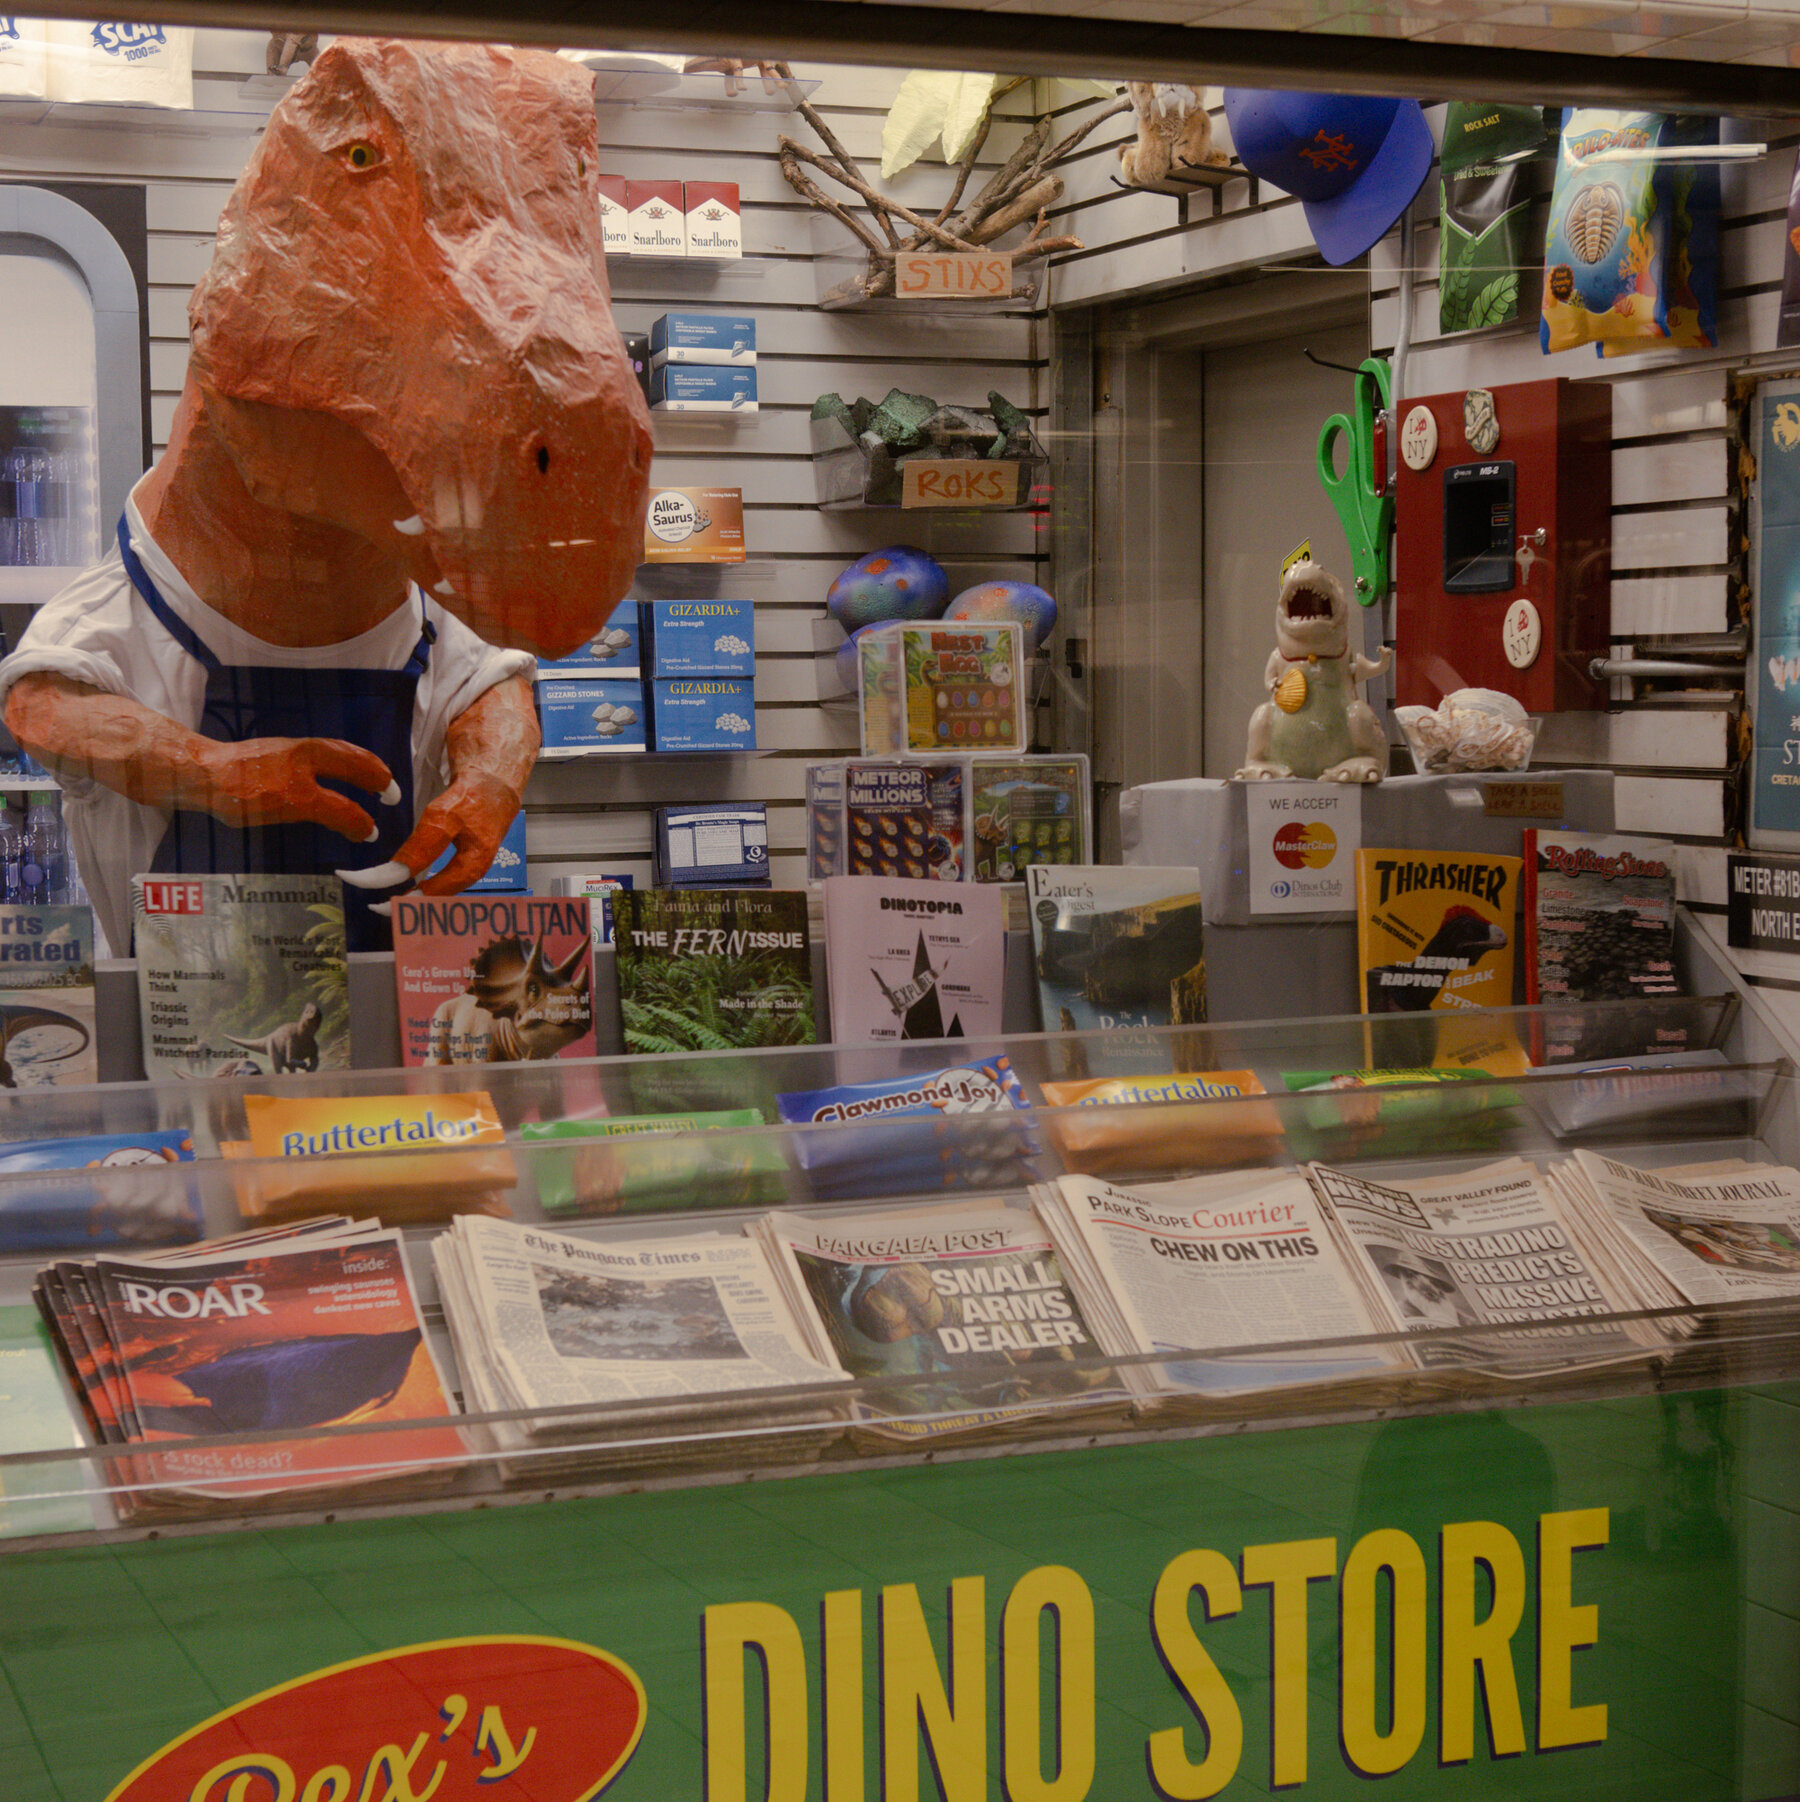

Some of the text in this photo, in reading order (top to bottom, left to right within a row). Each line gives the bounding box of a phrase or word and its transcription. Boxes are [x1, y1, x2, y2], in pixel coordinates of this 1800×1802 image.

[124, 47, 148, 62] 1000
[1463, 114, 1500, 133] ROCK SALT
[634, 230, 682, 246] Snarlboro
[691, 232, 738, 248] Snarlboro
[902, 259, 1005, 293] STIXS
[1408, 440, 1428, 460] NY
[918, 470, 1004, 500] ROKS
[654, 500, 684, 513] Alka-
[653, 514, 693, 526] Saurus
[670, 604, 741, 616] GIZARDIA+
[680, 620, 704, 628] Strength
[1510, 634, 1530, 660] NY
[578, 690, 604, 698] STONES
[670, 683, 742, 694] GIZARDIA+
[680, 699, 706, 707] Strength
[854, 771, 922, 786] METEOR
[850, 788, 924, 804] MILLIONS
[1270, 798, 1338, 810] WE ACCEPT
[1275, 840, 1336, 851] MasterClaw
[1545, 846, 1666, 880] Rolling Stone
[1032, 868, 1094, 898] Eater's
[1321, 880, 1343, 892] Club
[1375, 861, 1507, 912] THRASHER
[1734, 866, 1772, 896] METER
[146, 886, 338, 912] LIFE Mammals
[654, 900, 772, 914] Fauna and Flora
[880, 898, 963, 915] DINOTOPIA
[398, 903, 586, 936] DINOPOLITAN
[1752, 908, 1790, 939] NORTH
[0, 939, 81, 962] rated
[631, 930, 804, 956] THE FERN ISSUE
[1414, 956, 1470, 970] DEMON
[149, 970, 226, 980] How Mammals
[1380, 973, 1444, 987] RAPTOR
[1452, 968, 1495, 990] BEAK
[149, 981, 178, 993] Think
[404, 982, 420, 992] And
[452, 982, 466, 994] Up
[546, 992, 590, 1004] Secrets of
[720, 999, 804, 1009] Made in the Shade
[151, 1002, 188, 1014] Triassic
[528, 1010, 590, 1019] the Paleo Diet
[1120, 1012, 1132, 1020] The
[152, 1016, 189, 1028] Origins
[153, 1034, 198, 1046] Mammal
[409, 1033, 442, 1044] Fashion
[206, 1048, 250, 1059] Paradise
[1080, 1078, 1241, 1107] Buttertalon
[813, 1082, 997, 1123] Clawmond Joy
[283, 1110, 480, 1156] Buttertalon
[1602, 1159, 1627, 1179] THE
[1666, 1180, 1717, 1200] STREET
[1420, 1196, 1452, 1204] GREAT
[1454, 1188, 1494, 1201] VALLEY
[1494, 1180, 1532, 1193] FOUND
[1088, 1196, 1133, 1218] PARK
[1193, 1202, 1296, 1230] Courier
[523, 1233, 558, 1254] The
[639, 1250, 701, 1266] Times
[816, 1228, 1012, 1257] PANGAEA POST
[1150, 1237, 1220, 1262] CHEW
[1222, 1240, 1256, 1262] ON
[1258, 1237, 1318, 1260] THIS
[1399, 1225, 1567, 1260] NOSTRADINO
[343, 1258, 390, 1274] inside:
[1449, 1250, 1586, 1286] PREDICTS
[930, 1261, 1062, 1296] SMALL
[126, 1283, 272, 1318] ROAR
[1475, 1276, 1603, 1310] MASSIVE
[961, 1290, 1074, 1325] ARMS
[938, 1320, 1088, 1354] DEALER
[931, 1414, 992, 1431] THREAT A
[183, 1452, 225, 1468] rock
[230, 1452, 292, 1468] dead?
[701, 1506, 1610, 1802] DINO STORE
[189, 1694, 537, 1802] Rex's
